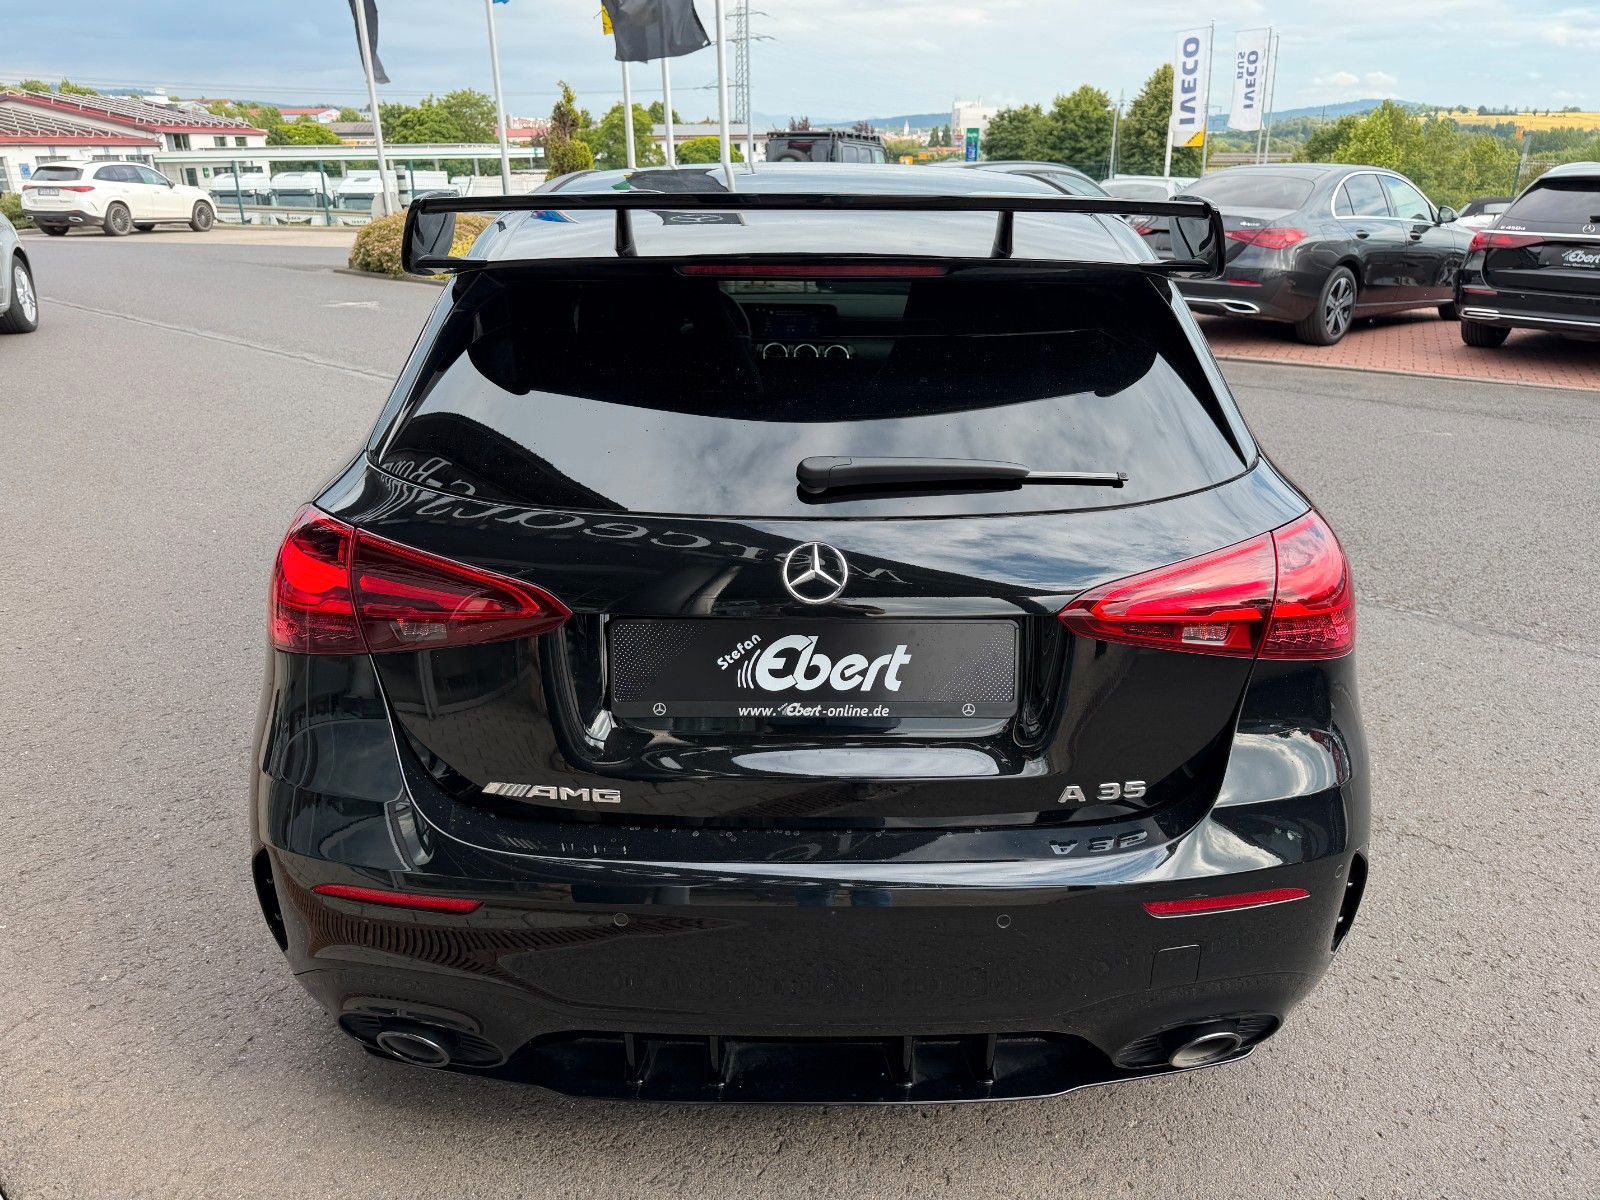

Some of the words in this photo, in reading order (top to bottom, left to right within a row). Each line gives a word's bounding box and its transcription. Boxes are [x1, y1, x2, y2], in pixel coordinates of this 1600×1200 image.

[716, 634, 762, 671] Stefan
[755, 634, 912, 692] Ebert
[526, 785, 621, 804] AMG
[1057, 784, 1087, 803] A
[1097, 780, 1147, 801] 35
